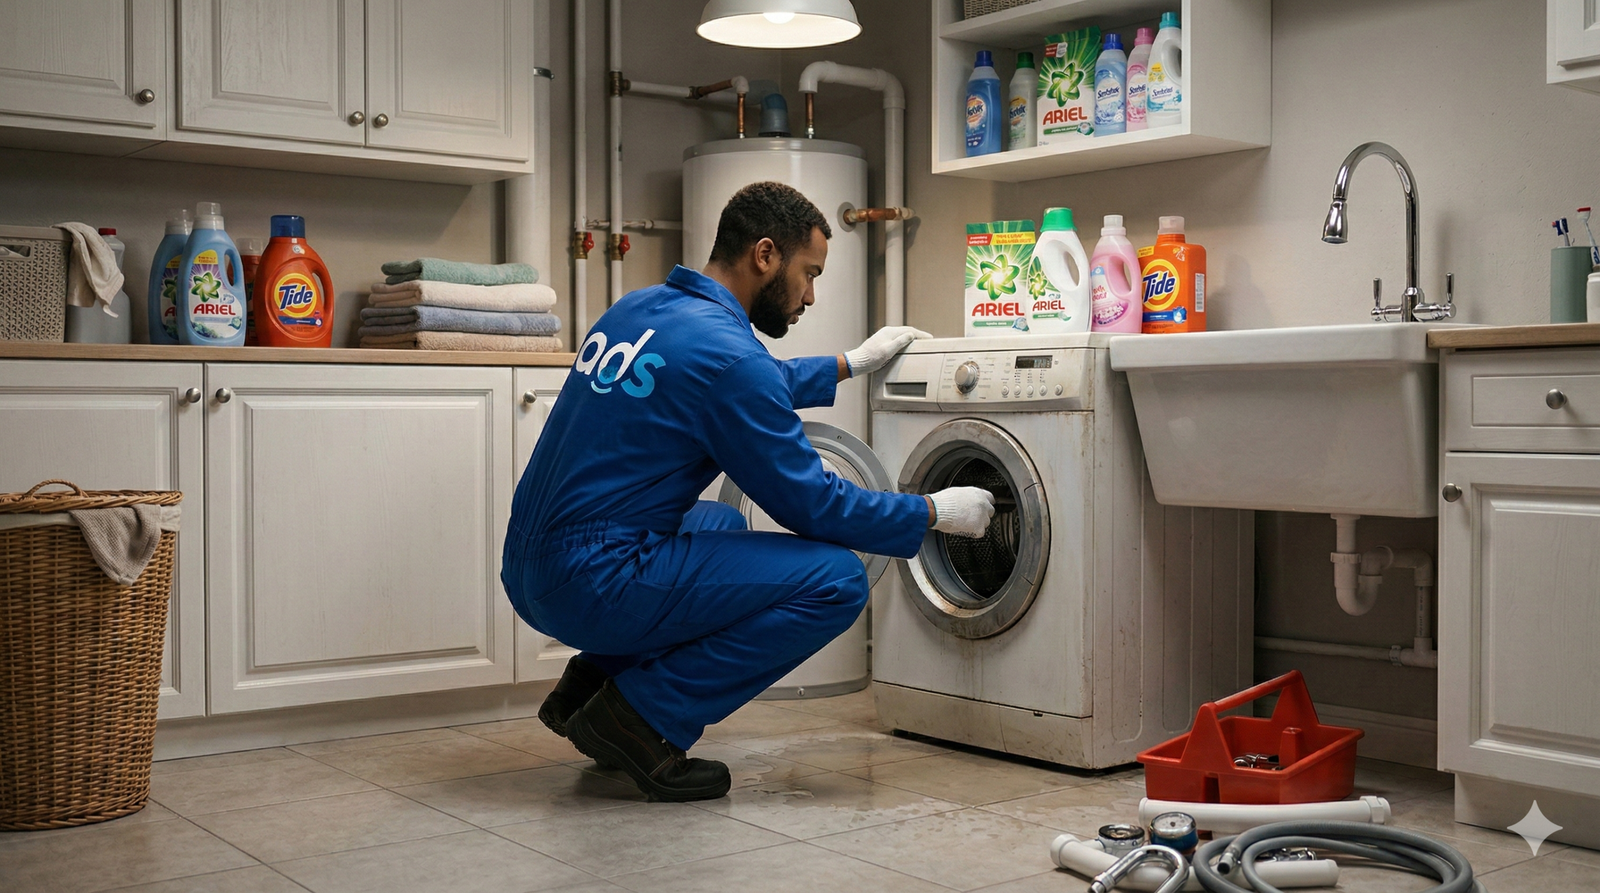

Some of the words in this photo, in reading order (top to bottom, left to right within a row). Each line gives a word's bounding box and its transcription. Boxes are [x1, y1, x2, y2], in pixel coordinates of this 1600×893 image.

[1042, 106, 1088, 126] ARIEL
[278, 284, 313, 310] Tide
[1142, 271, 1176, 304] Tide
[193, 303, 236, 316] ARIEL
[971, 302, 1025, 317] ARIEL
[1032, 300, 1066, 312] ARIEL
[575, 328, 666, 398] ads
